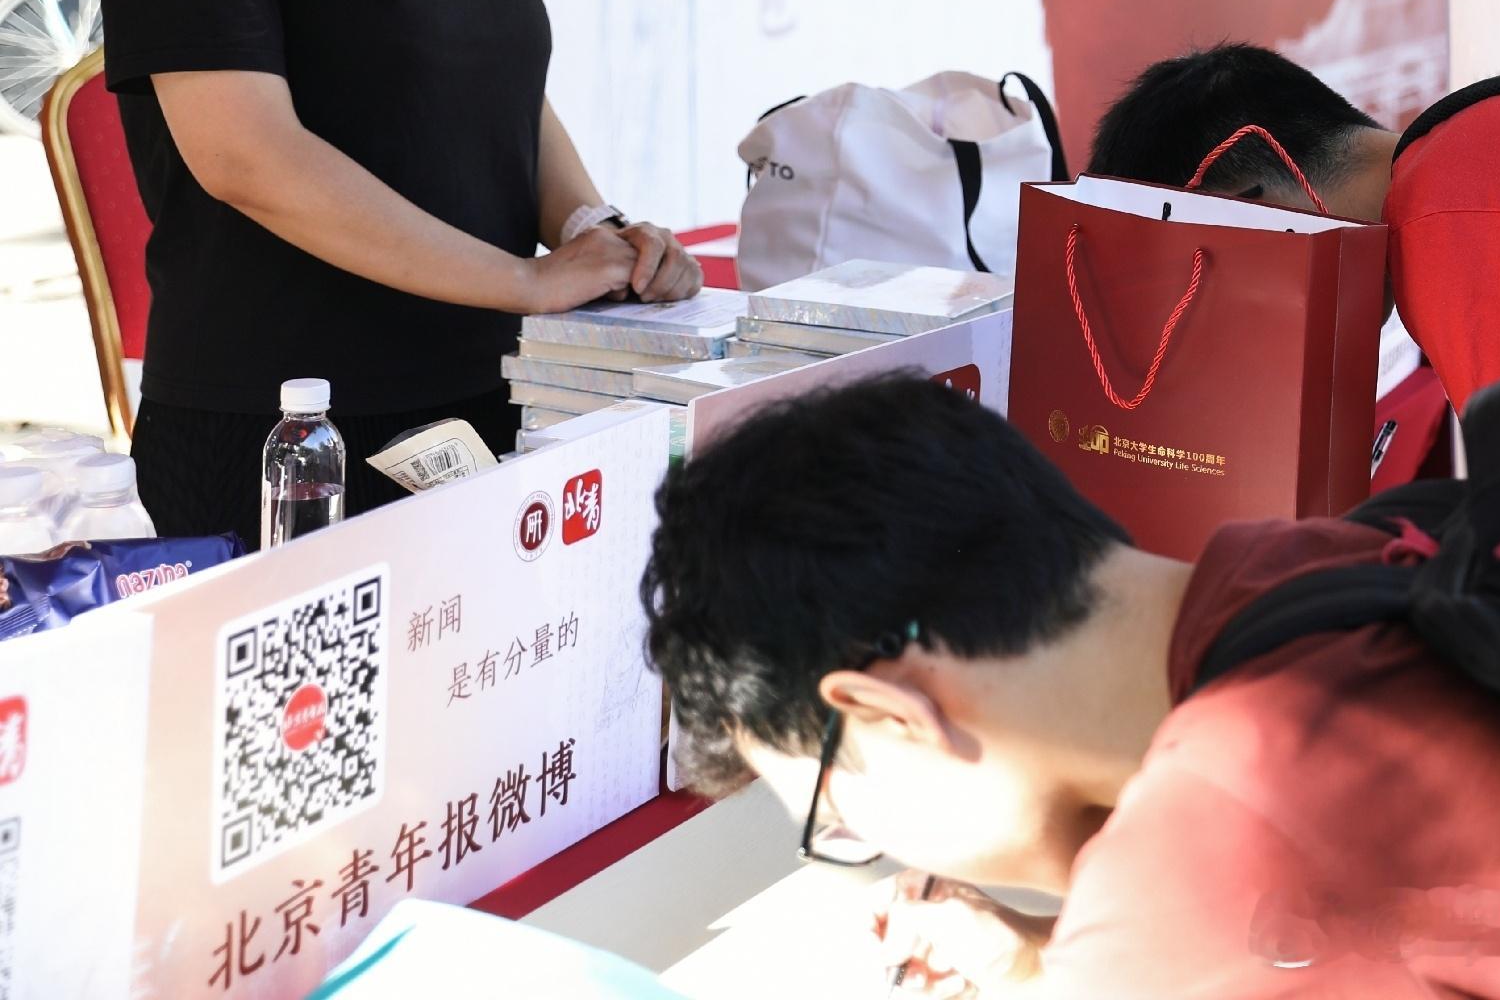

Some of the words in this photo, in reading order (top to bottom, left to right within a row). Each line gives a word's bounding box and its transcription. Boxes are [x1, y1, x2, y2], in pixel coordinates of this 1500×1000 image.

[1113, 436, 1226, 466] 北京大学生命科学100周年
[1113, 448, 1136, 462] Peking
[1137, 453, 1174, 470] University
[1175, 461, 1189, 471] Life
[1191, 464, 1225, 476] Sciences
[408, 594, 461, 652] 新闻
[447, 611, 578, 708] 是有分量的
[208, 737, 577, 990] 北京青年报微博
